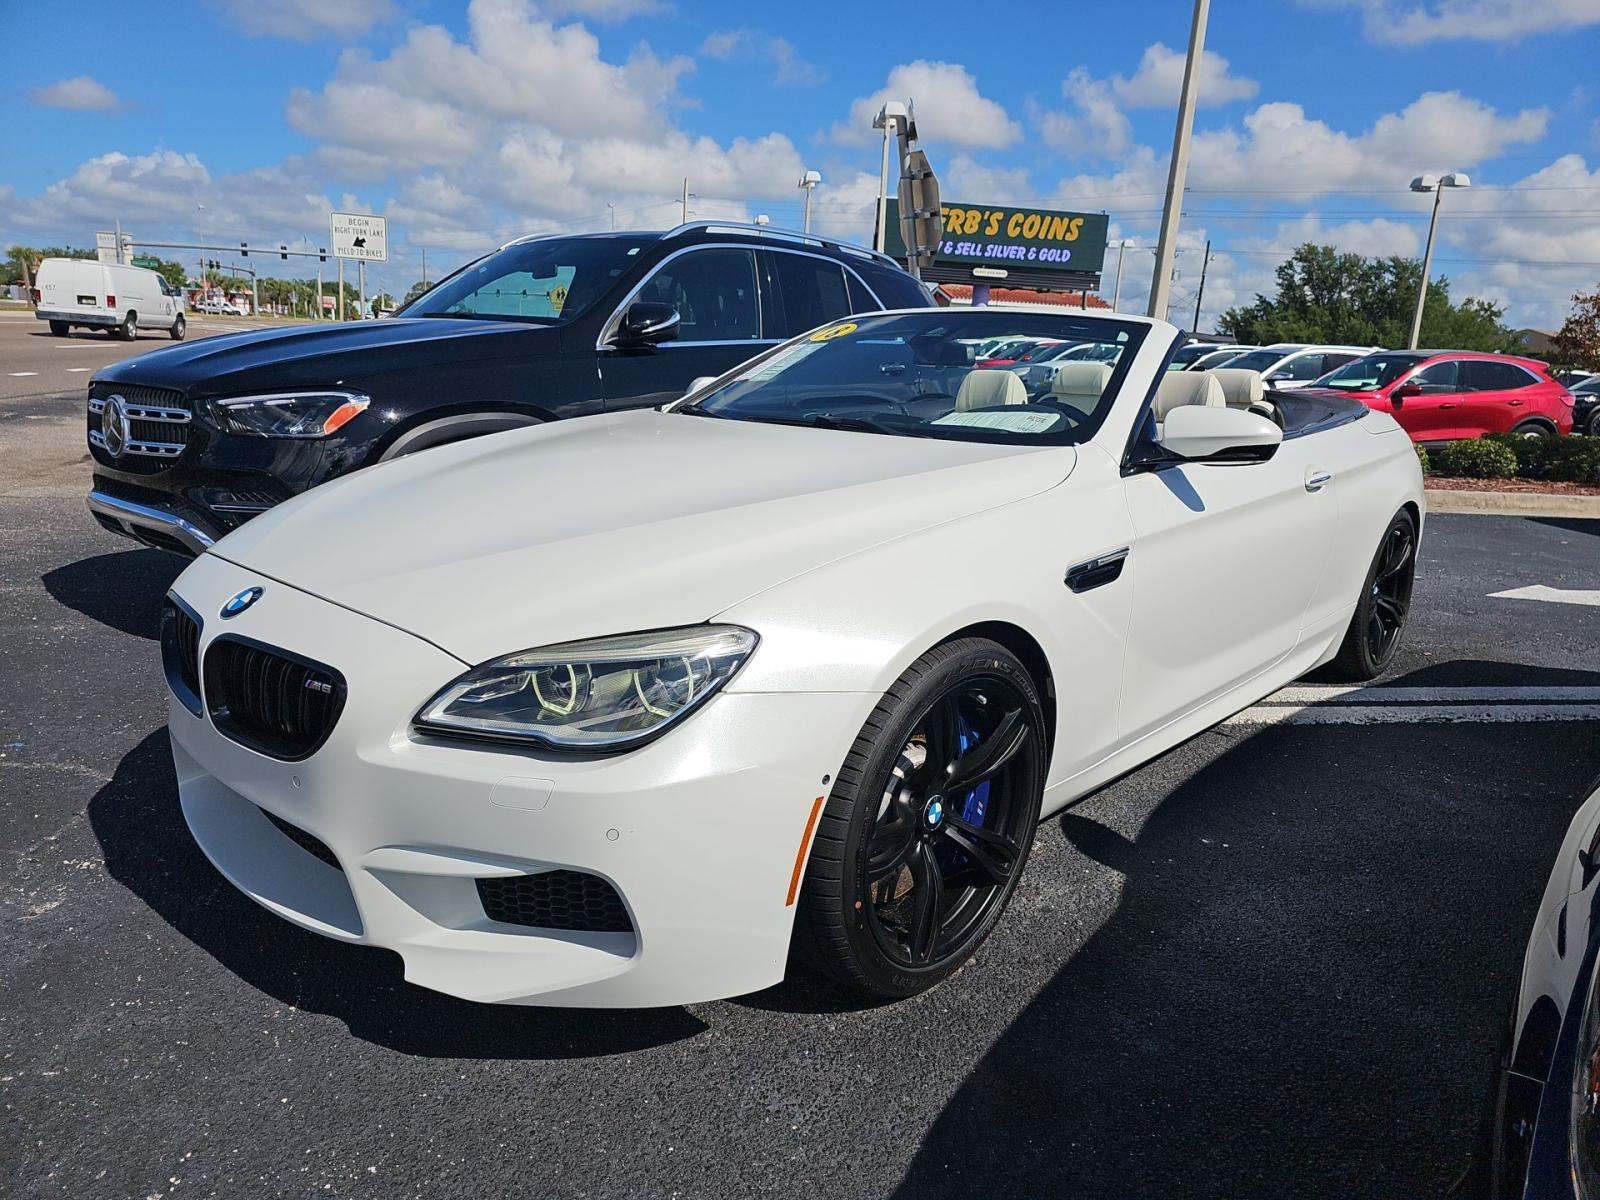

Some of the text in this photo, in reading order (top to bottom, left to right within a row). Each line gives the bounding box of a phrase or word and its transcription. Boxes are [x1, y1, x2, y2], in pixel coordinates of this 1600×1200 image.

[348, 218, 369, 226] BEGIN
[940, 208, 1084, 241] RB'S COINS
[335, 227, 350, 235] RIGHT
[369, 230, 384, 238] LANE
[366, 249, 383, 258] BIKES
[944, 241, 953, 255] &
[954, 241, 982, 256] SELL
[984, 244, 1026, 260] SILVER
[1027, 247, 1036, 260] &
[1038, 248, 1071, 262] GOLD
